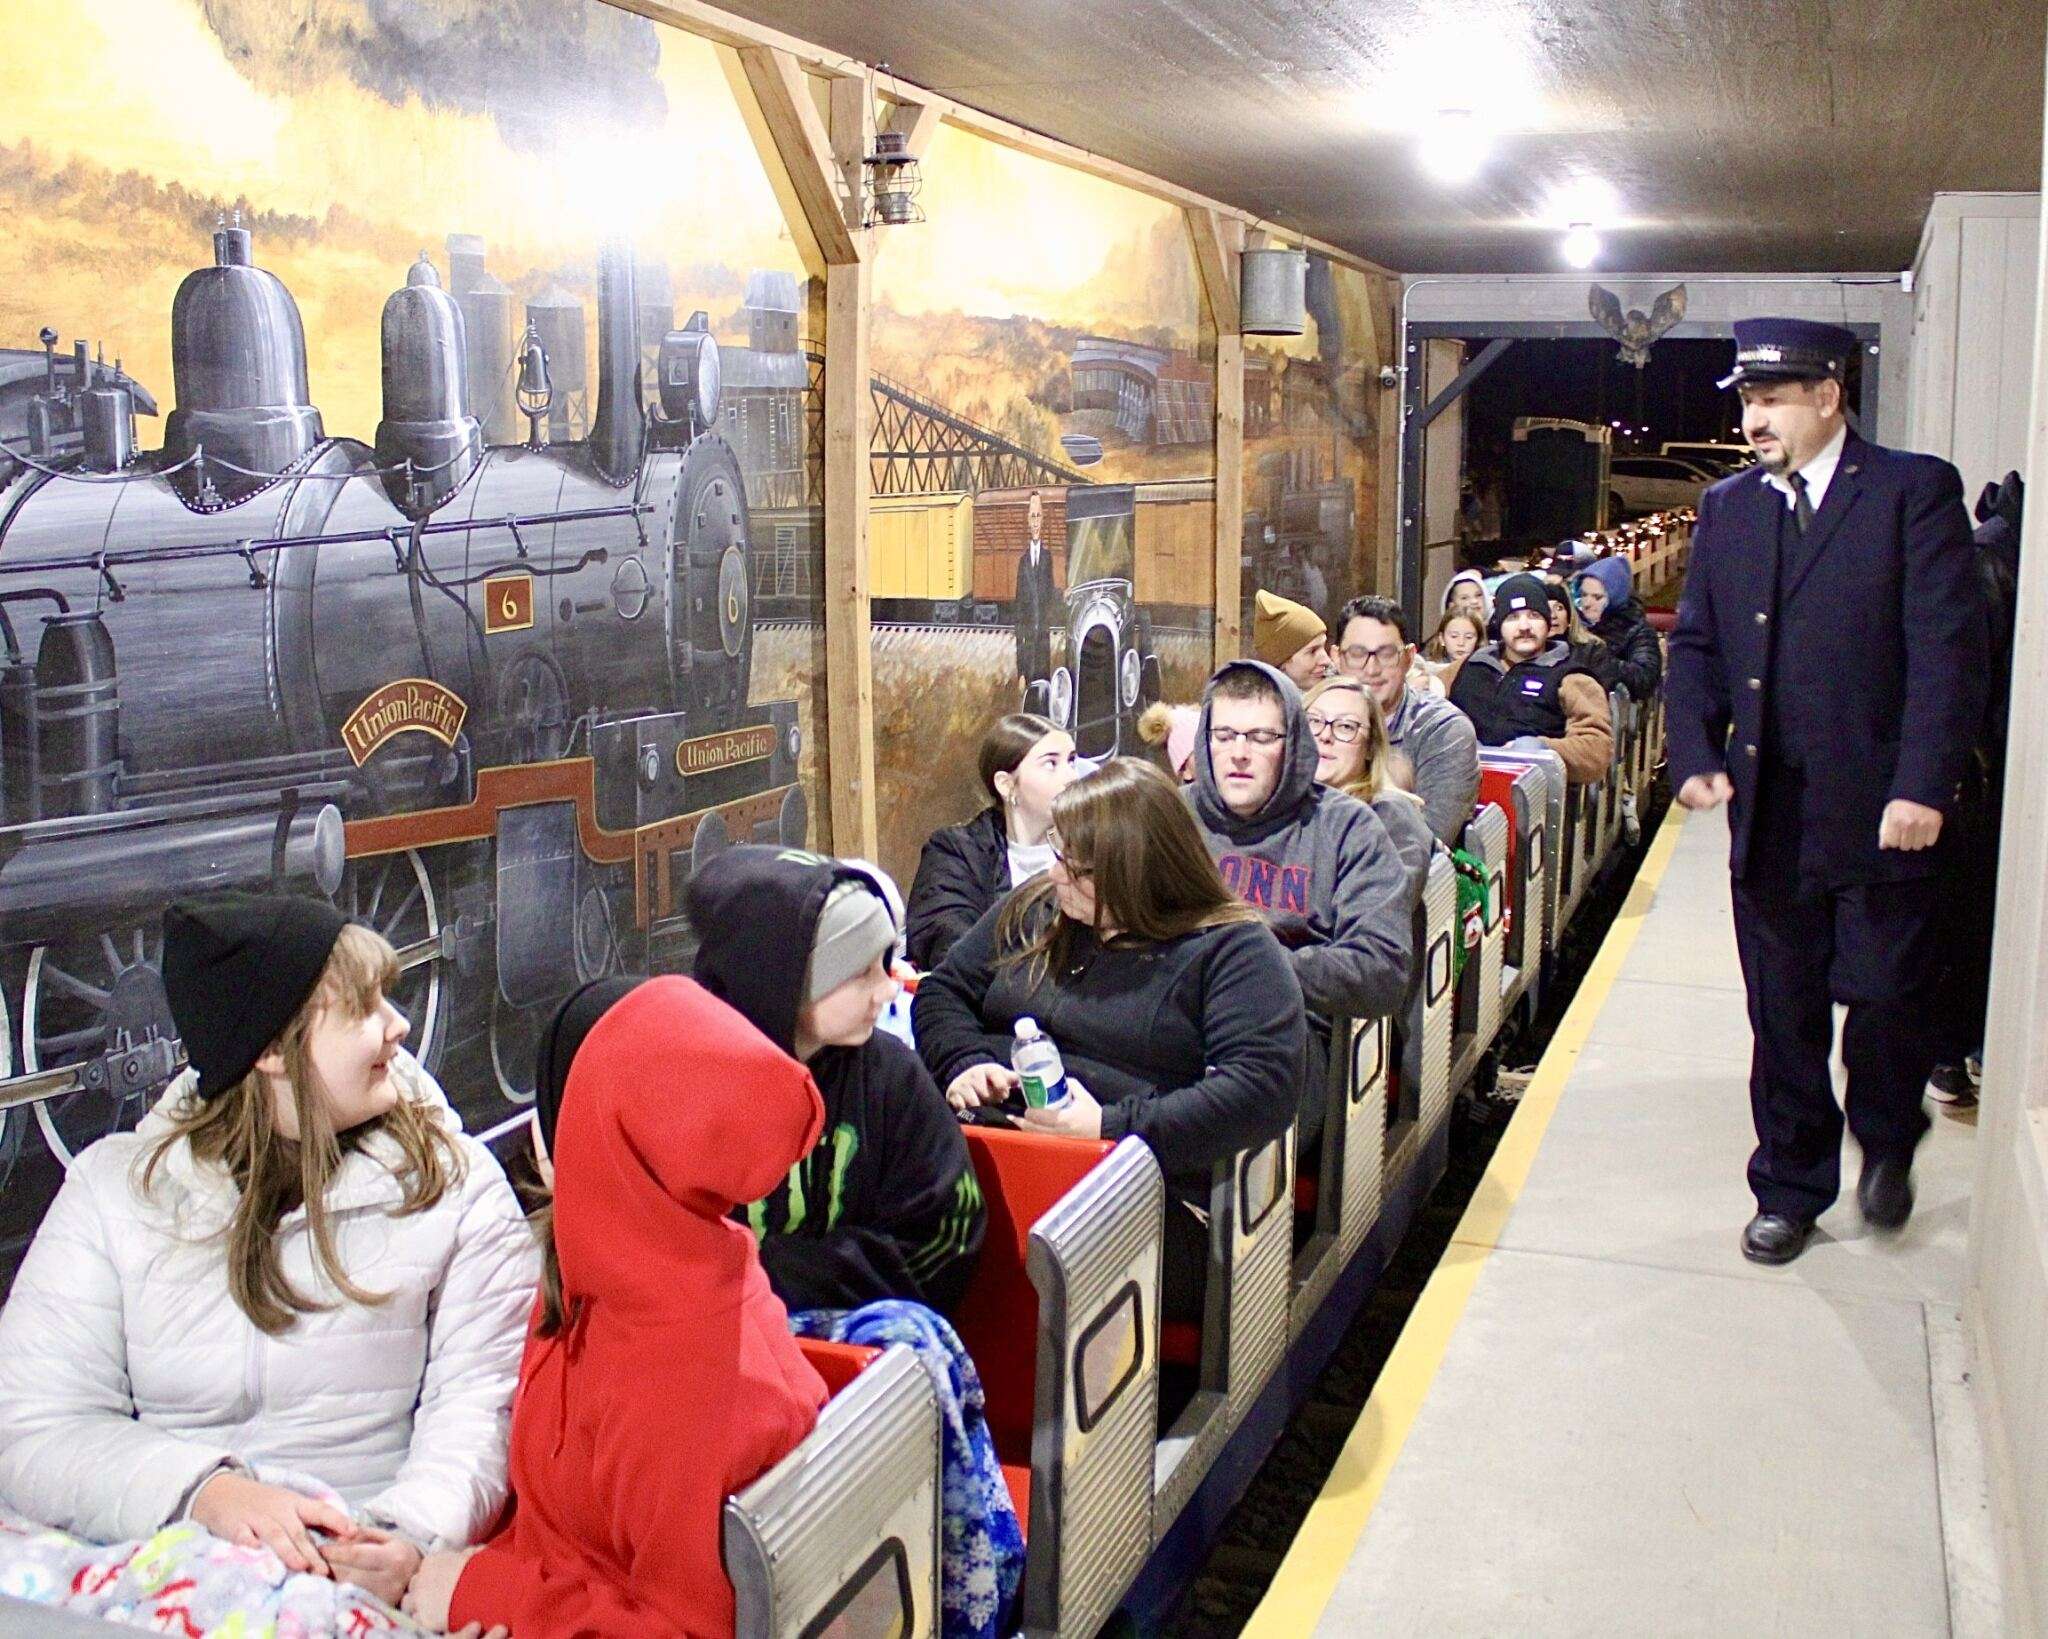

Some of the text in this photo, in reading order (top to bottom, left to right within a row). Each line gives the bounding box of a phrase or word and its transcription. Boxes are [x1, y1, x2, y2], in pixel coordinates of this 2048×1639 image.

[502, 587, 518, 620] 6
[728, 577, 739, 623] 6
[350, 699, 408, 748] Union
[687, 733, 767, 767] Union Pacific
